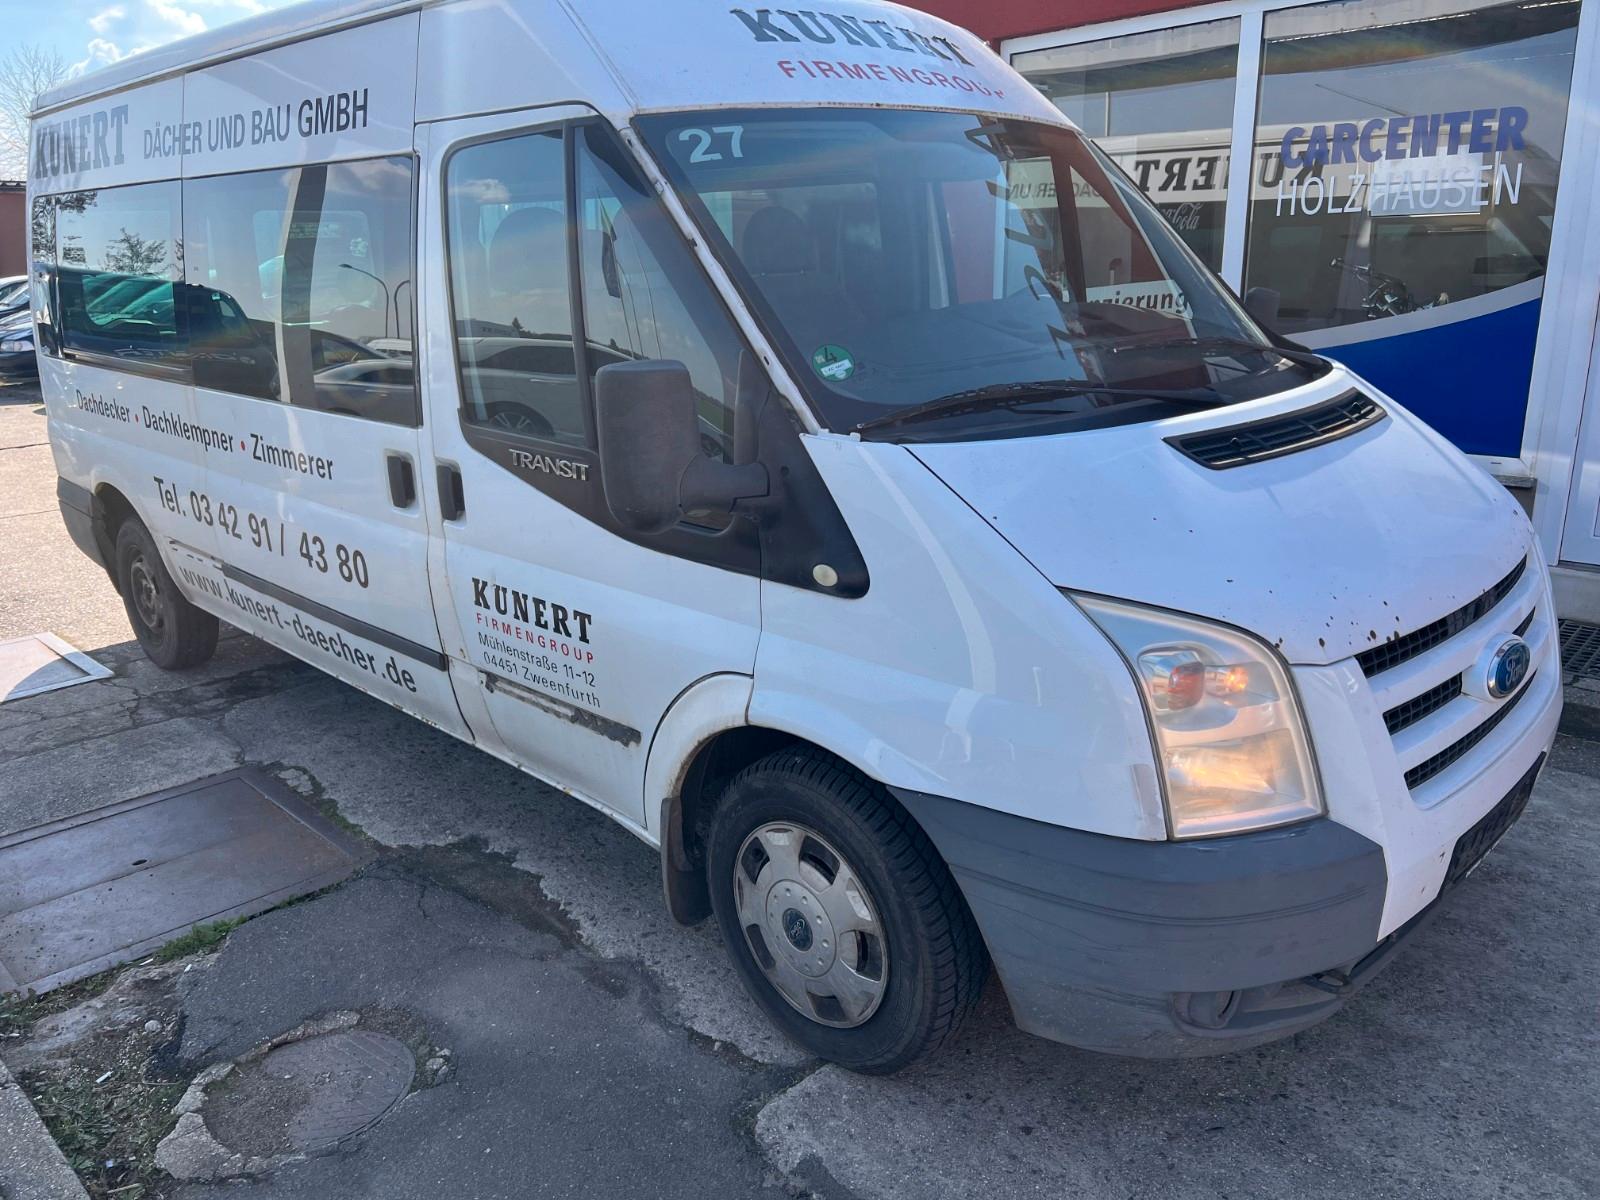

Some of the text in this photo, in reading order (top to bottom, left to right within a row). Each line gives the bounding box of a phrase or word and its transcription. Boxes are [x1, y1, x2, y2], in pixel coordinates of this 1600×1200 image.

[730, 9, 974, 67] KUNERT
[35, 88, 369, 179] KUNERT DÄCHER UND BAU GMBH
[678, 125, 744, 163] 27
[1281, 106, 1528, 169] CARCENTER
[1276, 162, 1523, 217] HOLZHAUSEN
[76, 389, 333, 480] Dachdecker Dachklempner Zimmerer
[508, 449, 589, 481] TRANSIT
[154, 476, 187, 517] Tel.
[336, 544, 369, 588] 80
[179, 566, 417, 693] www.kunert-daecher.de
[471, 577, 592, 644] KUNERT
[476, 613, 594, 664] FIRMENGROUP
[478, 631, 596, 687] Mühlenstraße 11-12
[483, 651, 601, 708] 04451 Zweenfurth
